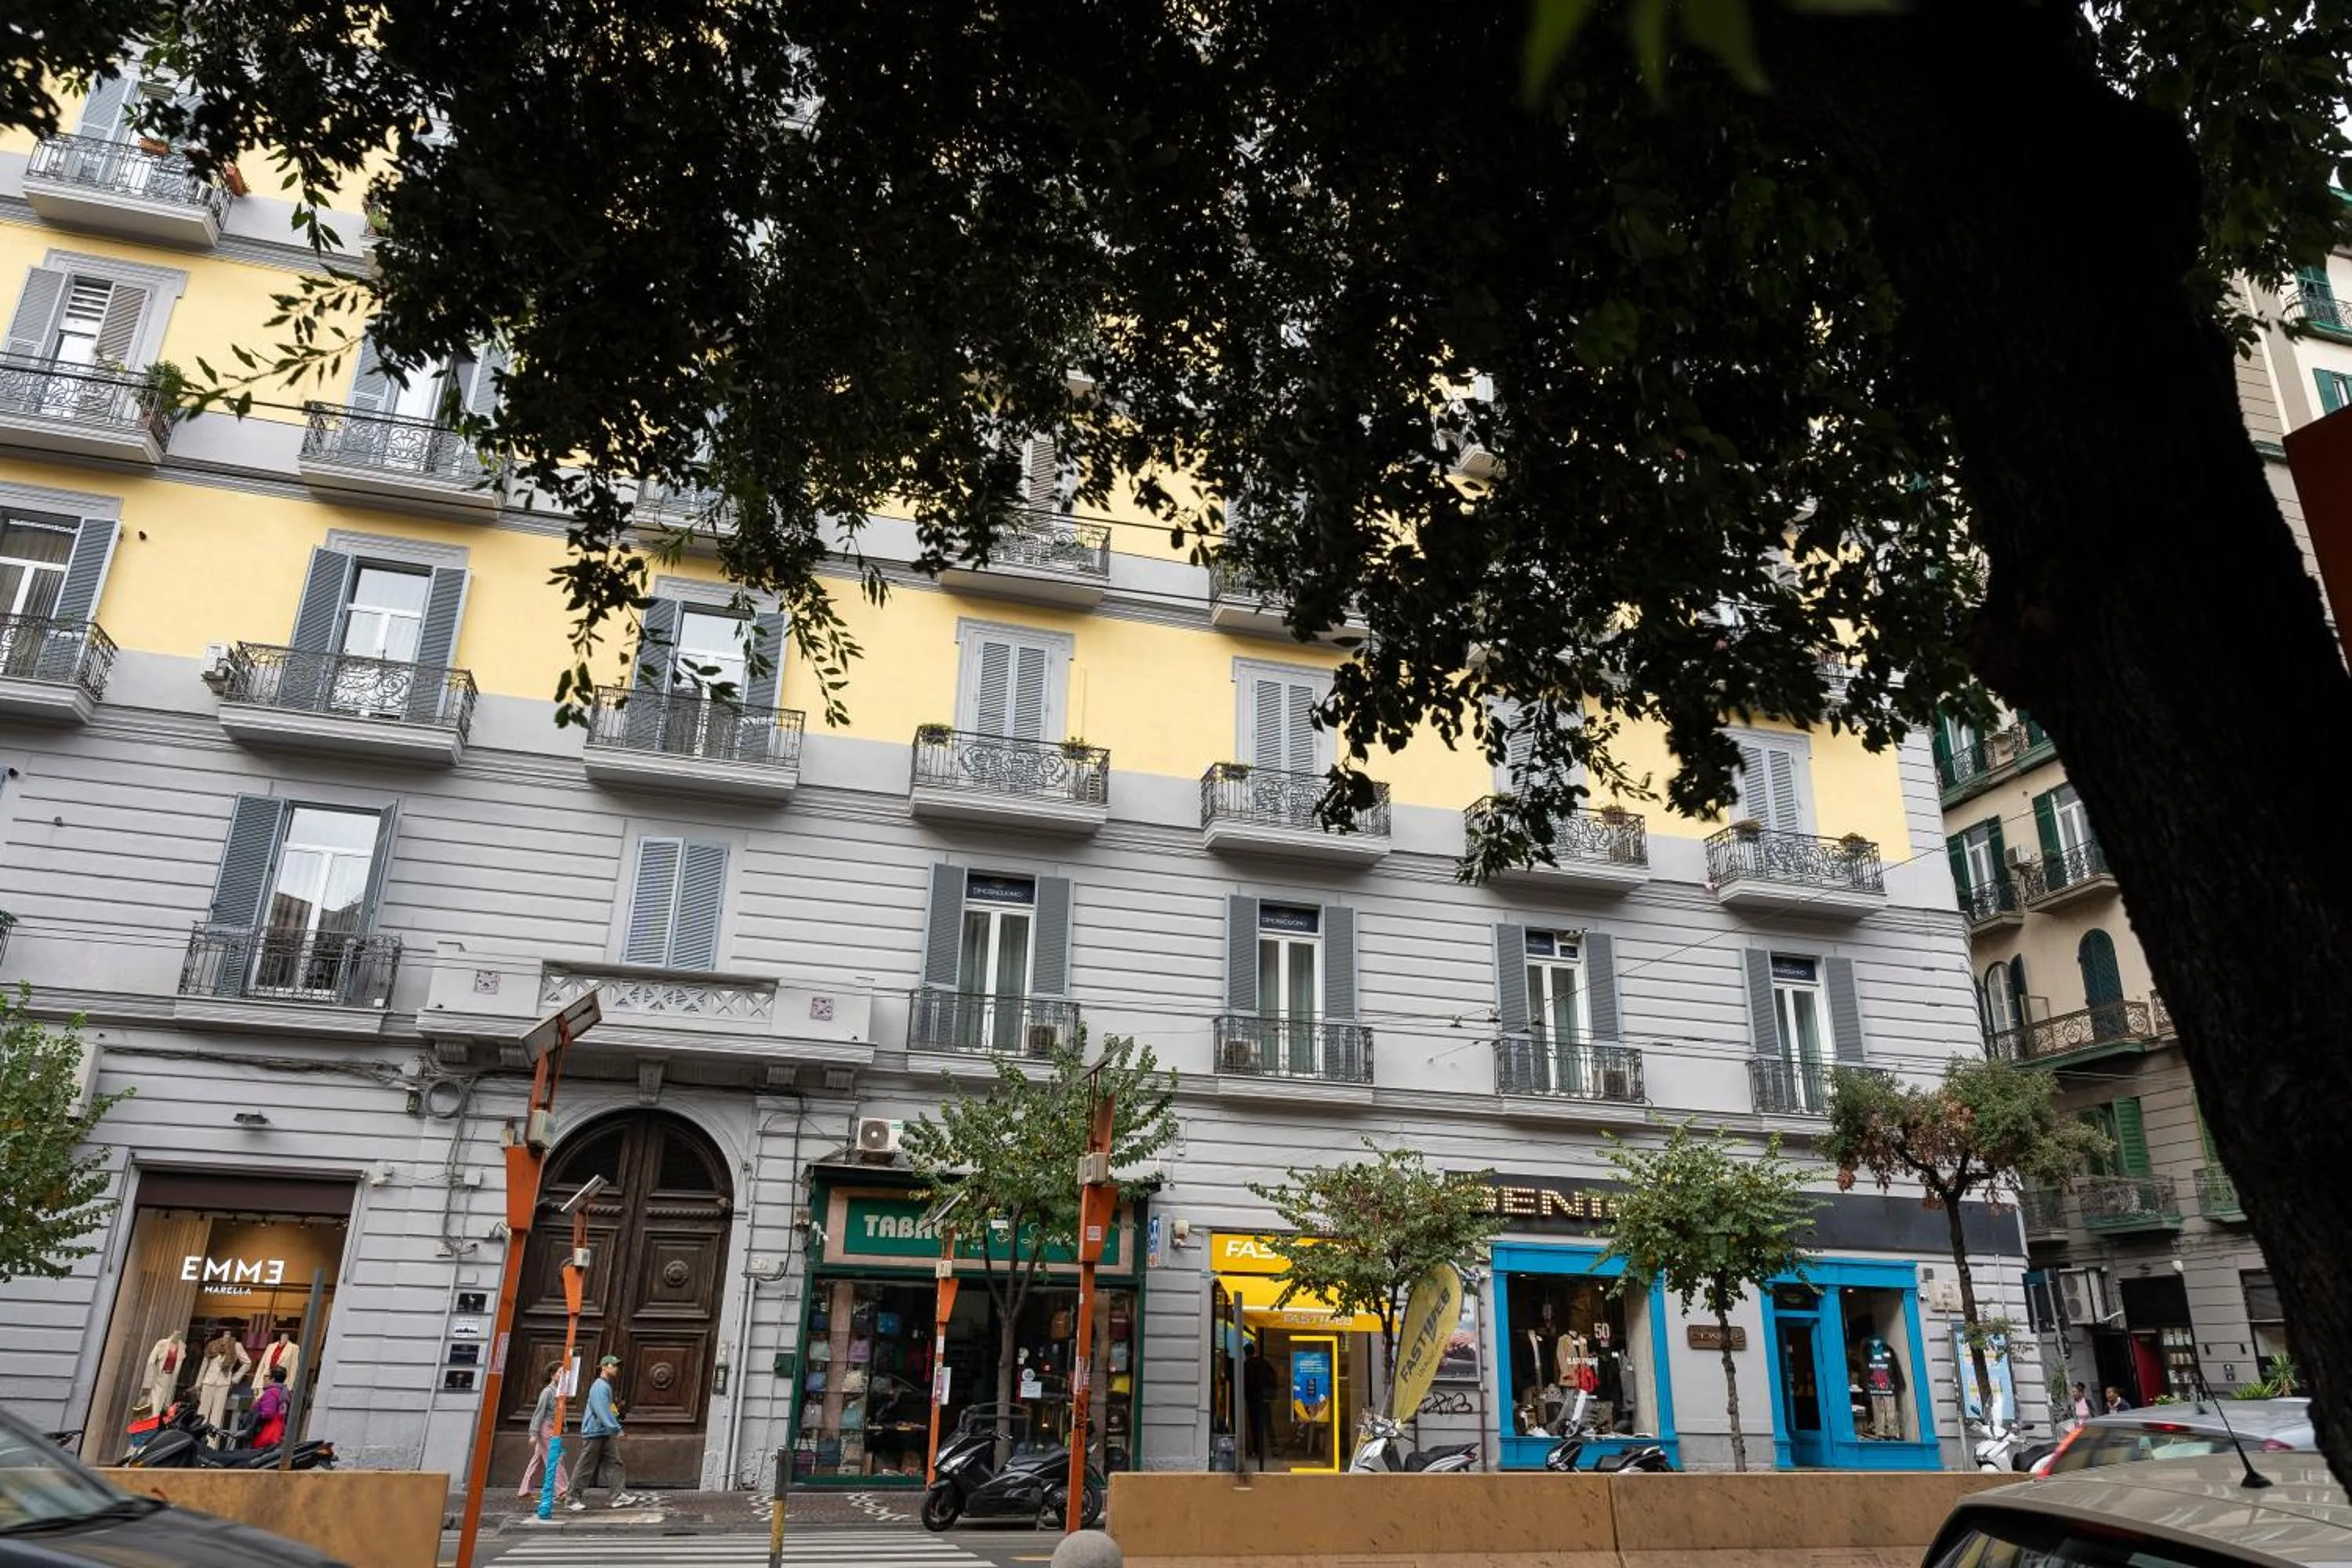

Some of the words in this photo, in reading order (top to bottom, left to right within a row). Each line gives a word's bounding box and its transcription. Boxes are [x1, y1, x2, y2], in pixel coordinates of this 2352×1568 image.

[205, 1286, 252, 1296] MARELLA
[1399, 1287, 1450, 1382] FASTWEB
[1594, 1323, 1610, 1340] 50
